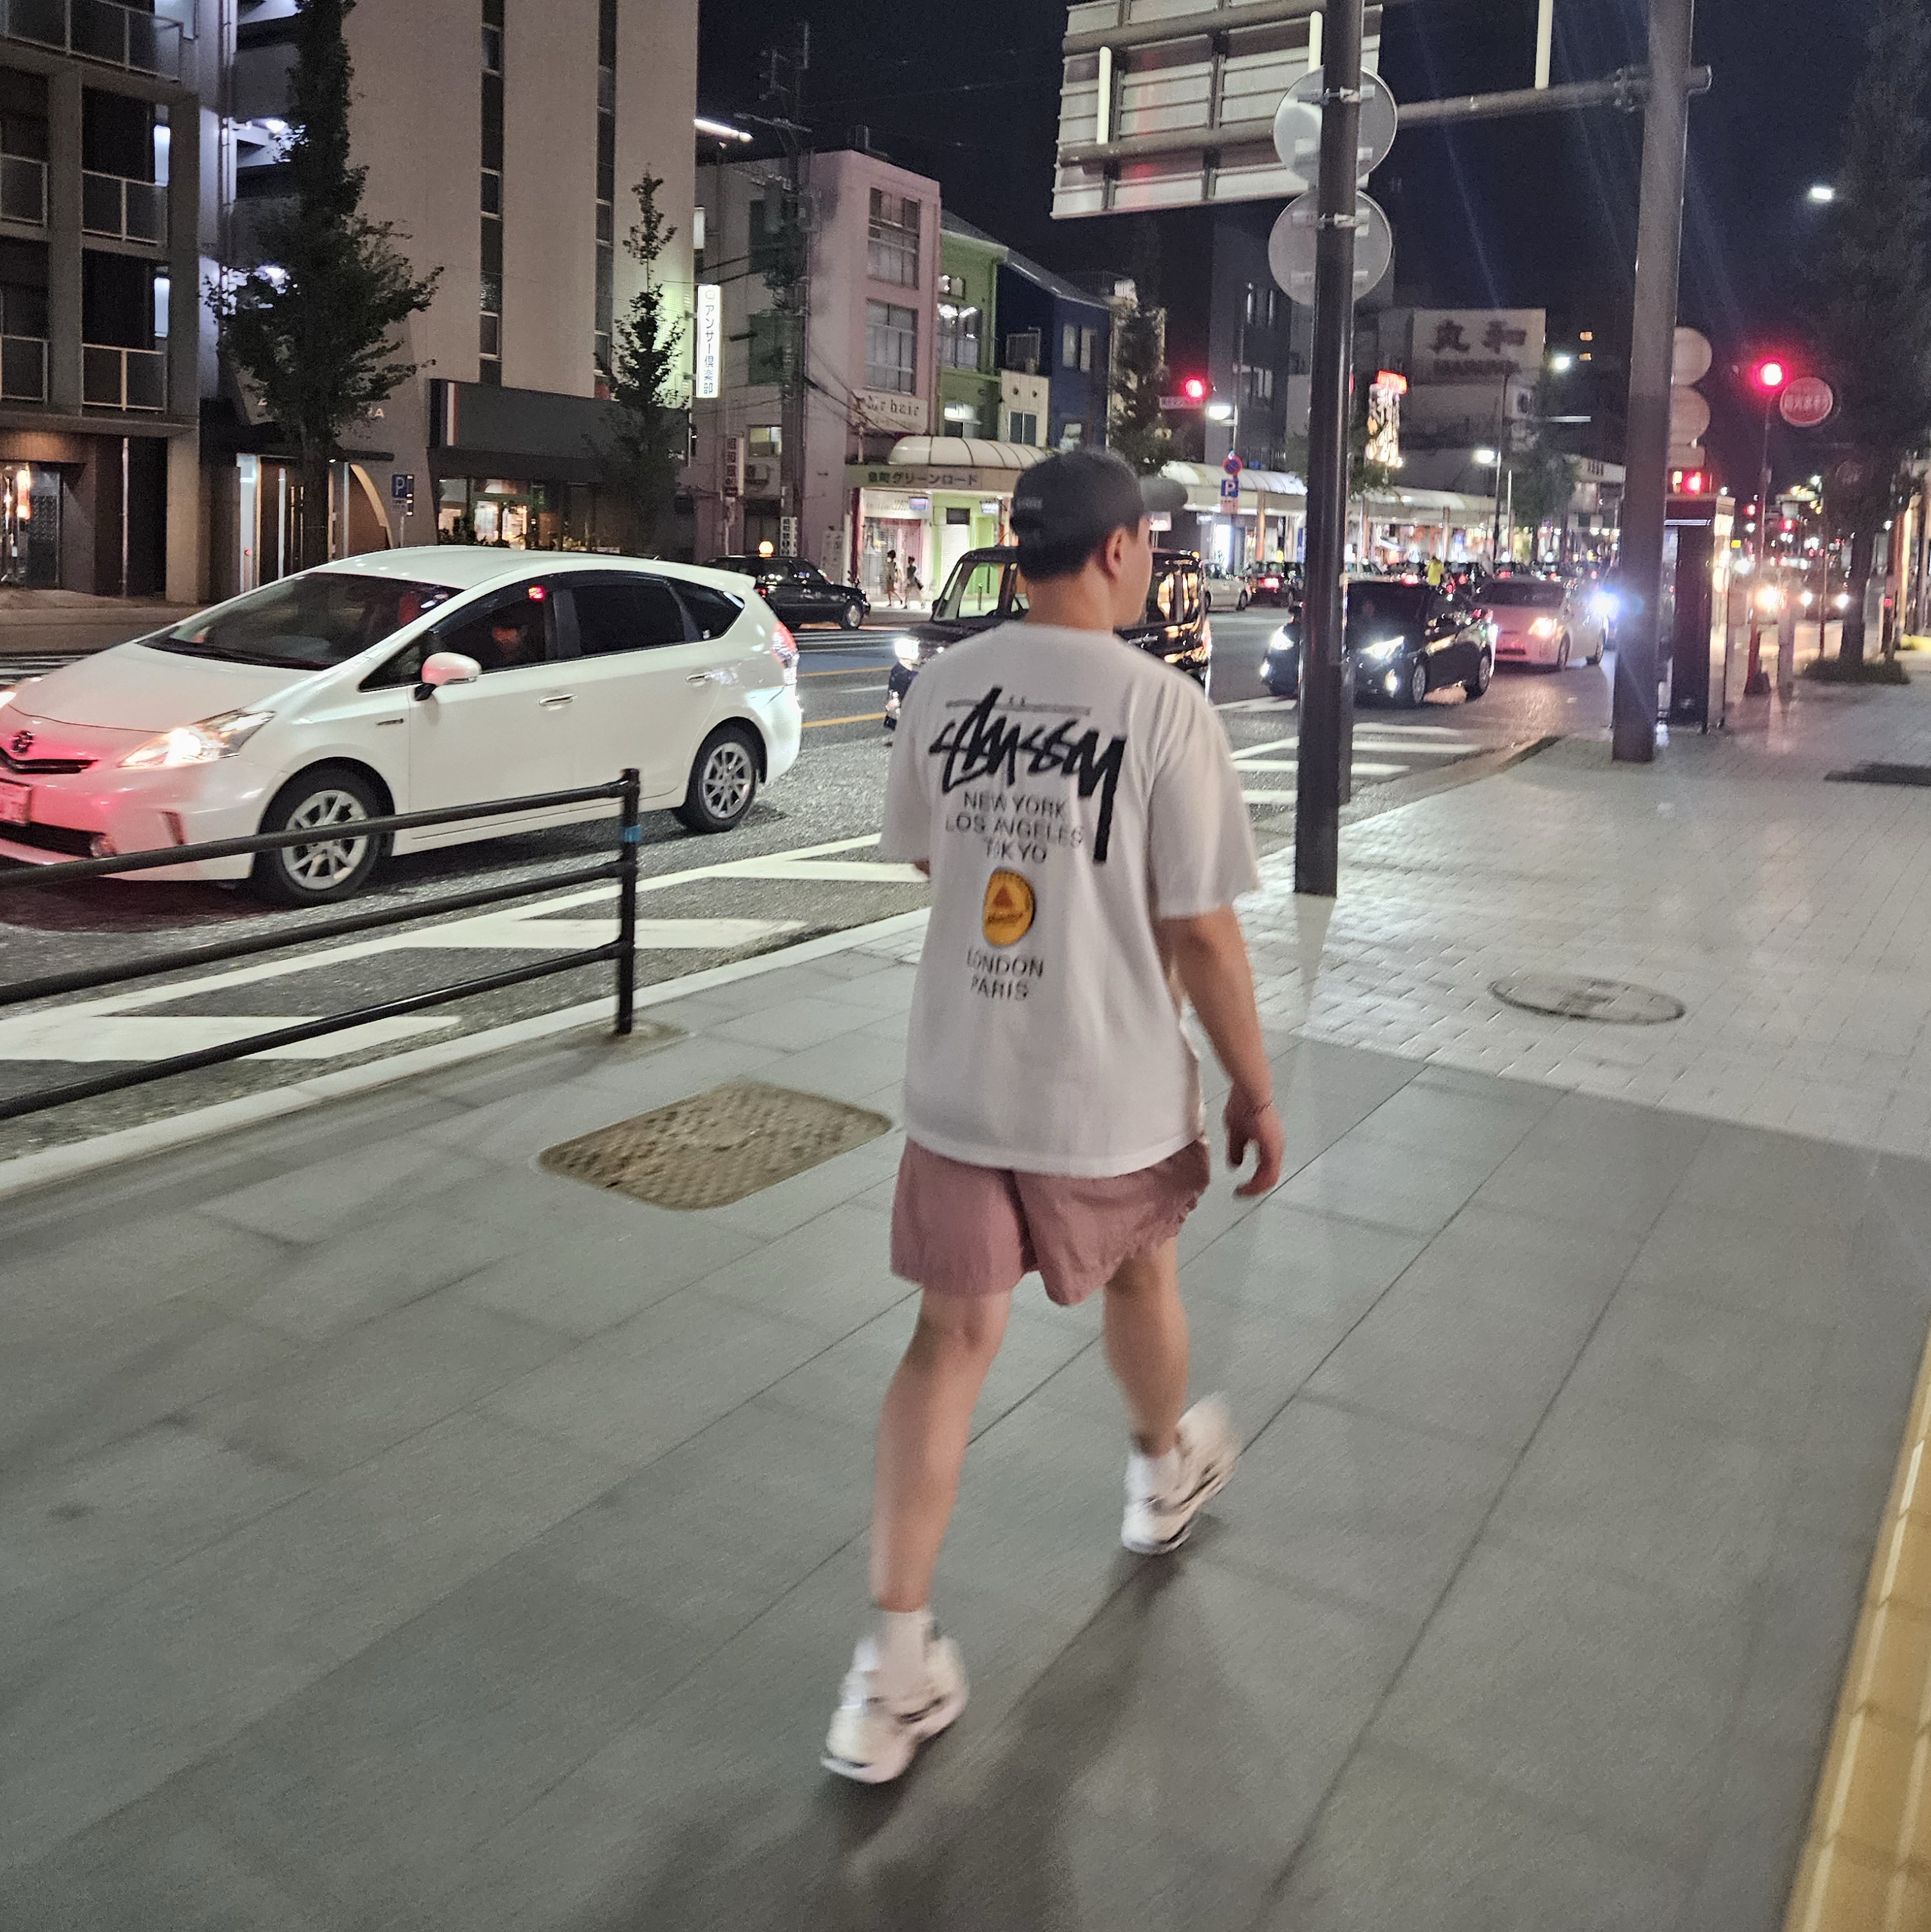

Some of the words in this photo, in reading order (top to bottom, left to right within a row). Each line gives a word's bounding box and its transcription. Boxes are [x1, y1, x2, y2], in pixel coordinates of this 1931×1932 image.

[704, 305, 715, 395] アンサー倶楽部
[1225, 479, 1237, 497] P
[964, 791, 1008, 812] NEW
[1012, 795, 1067, 819] YORK
[945, 813, 986, 834] LOS
[967, 947, 1045, 980] LONDON
[970, 973, 1030, 1002] PARIS
